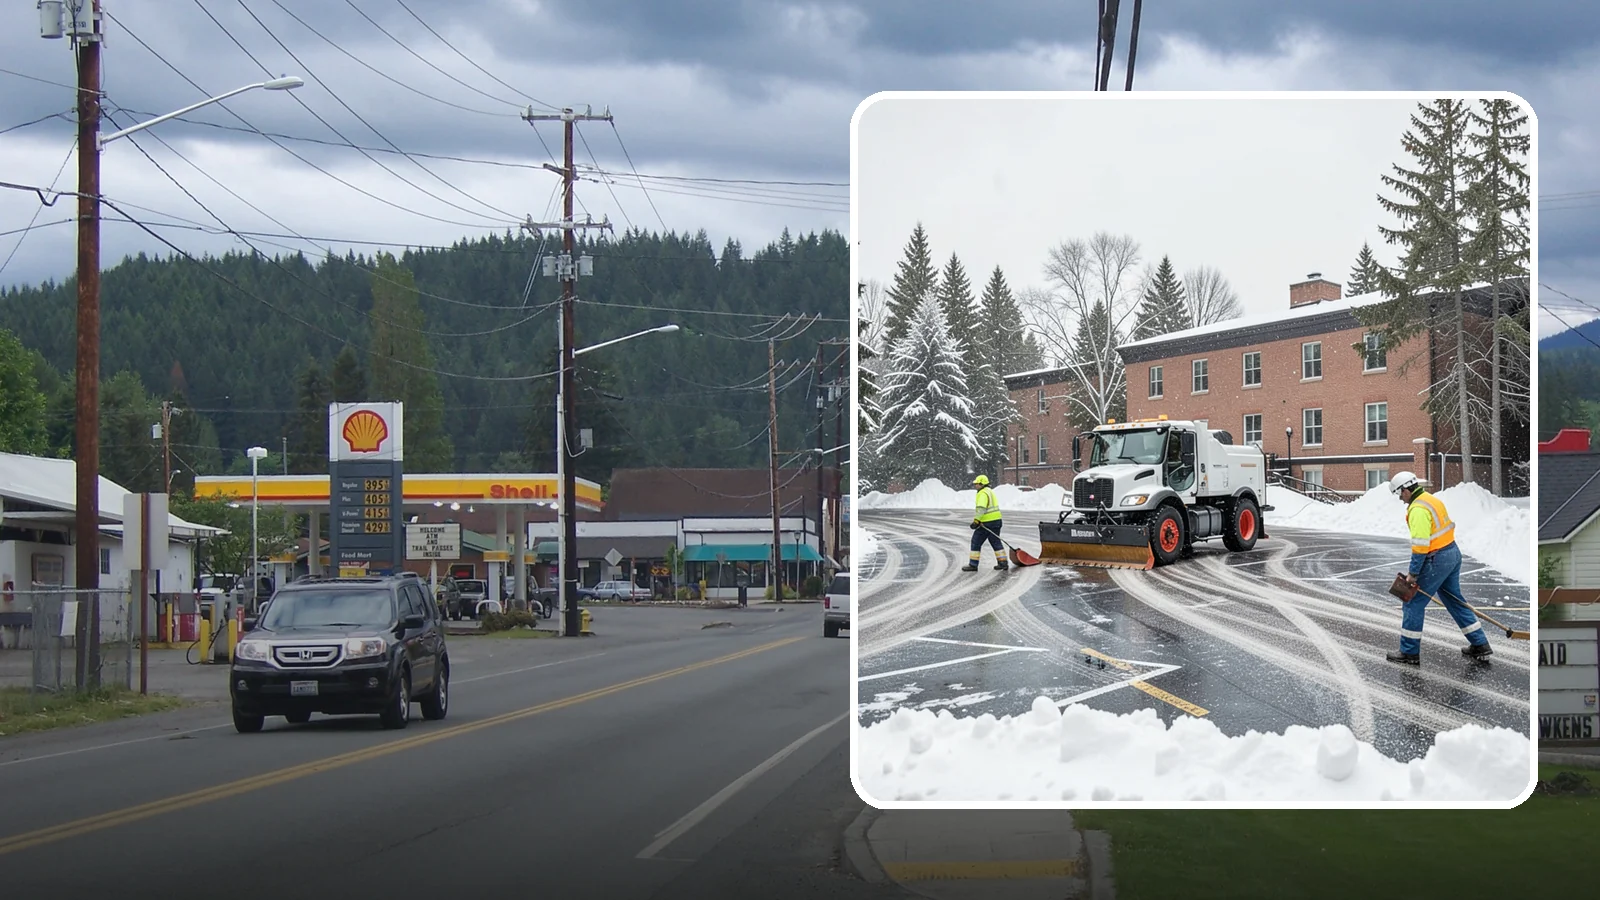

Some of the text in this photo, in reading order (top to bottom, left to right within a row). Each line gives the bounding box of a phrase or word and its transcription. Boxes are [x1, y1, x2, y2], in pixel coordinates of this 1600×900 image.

[366, 480, 384, 490] 395
[490, 484, 547, 499] Shell
[366, 494, 384, 504] 405
[366, 508, 384, 518] 415
[366, 523, 384, 532] 429
